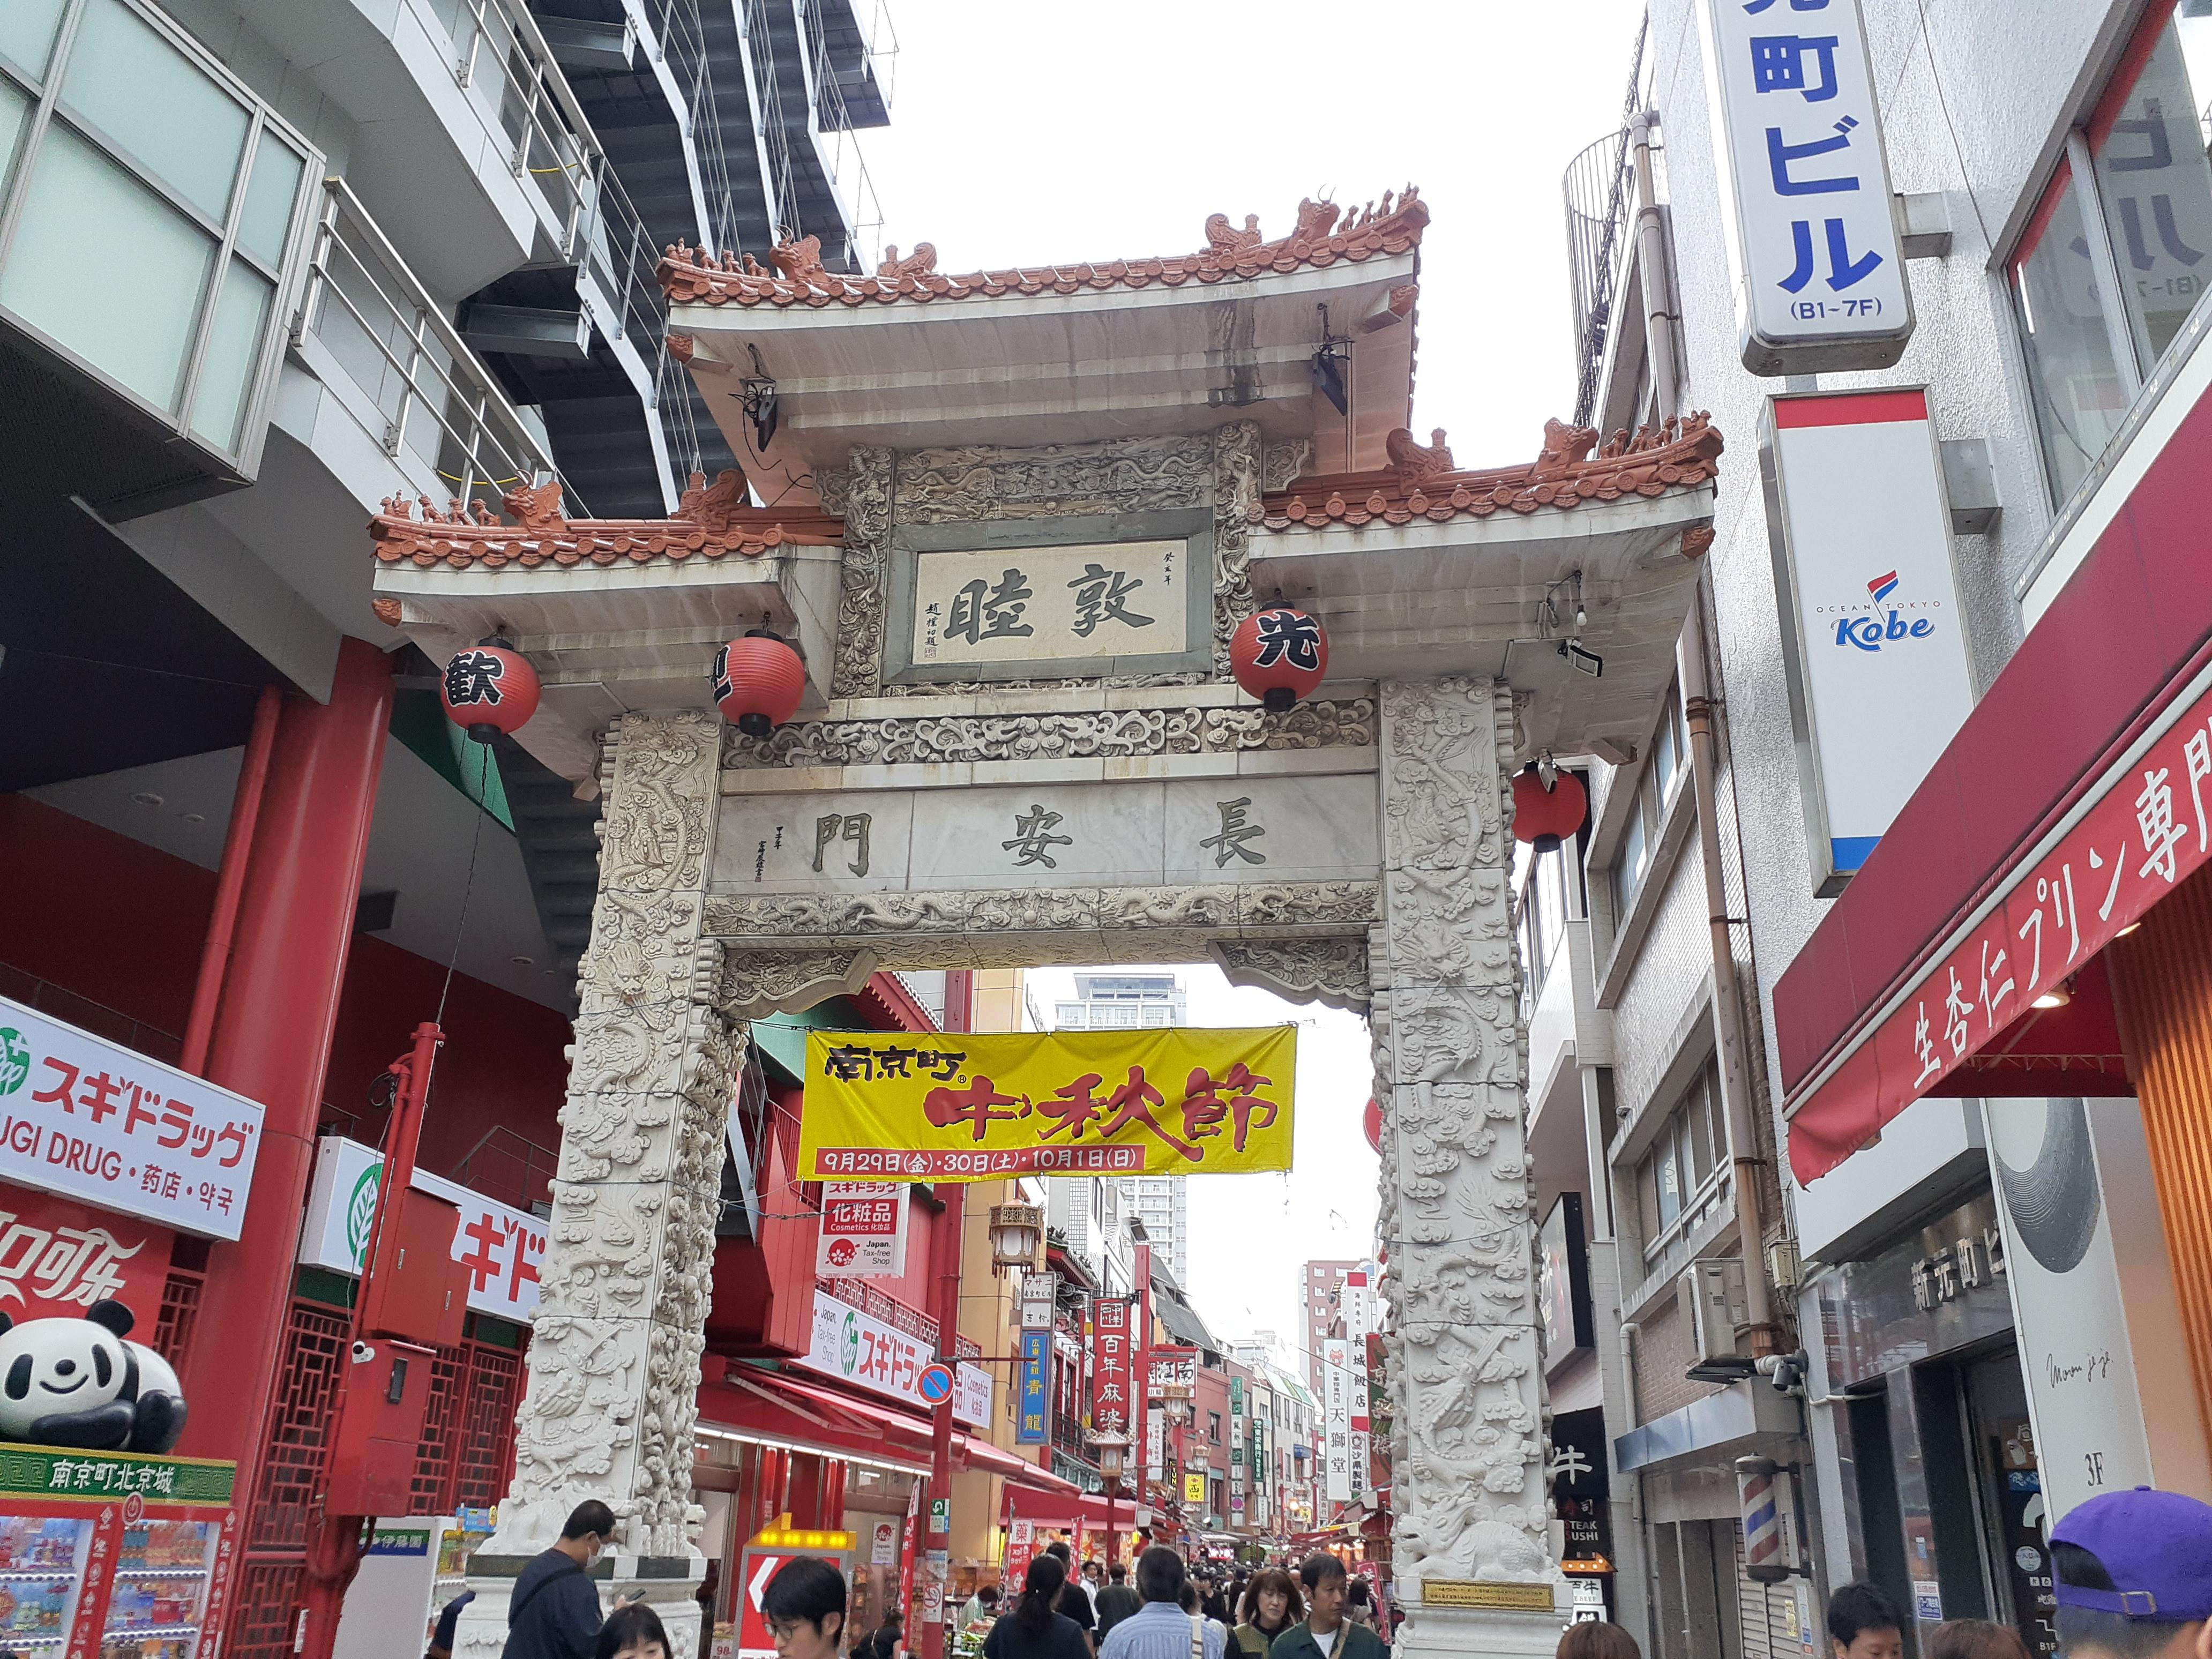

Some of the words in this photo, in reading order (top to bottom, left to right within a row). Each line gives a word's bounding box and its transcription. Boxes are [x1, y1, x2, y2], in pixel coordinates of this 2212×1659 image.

[1742, 0, 1883, 294] 町ビル
[1817, 604, 1871, 613] OCEAN
[1886, 601, 1940, 609] TOKYO
[1253, 610, 1320, 671] 光
[1830, 610, 1936, 652] Kobe
[774, 826, 783, 850] 甲子年
[824, 1045, 966, 1083] 南京町
[31, 1056, 254, 1168] スギドラッグ
[923, 1062, 1278, 1162] 中秋節
[829, 1182, 897, 1193] スギドラッグ
[832, 1202, 892, 1223] 化粧品
[0, 1211, 147, 1309] 口可乐
[817, 1324, 835, 1345] Tax-free
[822, 1346, 834, 1365] Shop
[859, 1332, 933, 1394] スギドラ
[1352, 1333, 1367, 1408] 長城飯店
[967, 1374, 988, 1398] Cosmetics
[1097, 1335, 1124, 1430] 百年麻婆
[1329, 1408, 1347, 1473] 天獅堂
[49, 1459, 175, 1494] 南京町北京城
[1553, 1445, 1593, 1485] 牛
[2085, 1452, 2103, 1486] 3F
